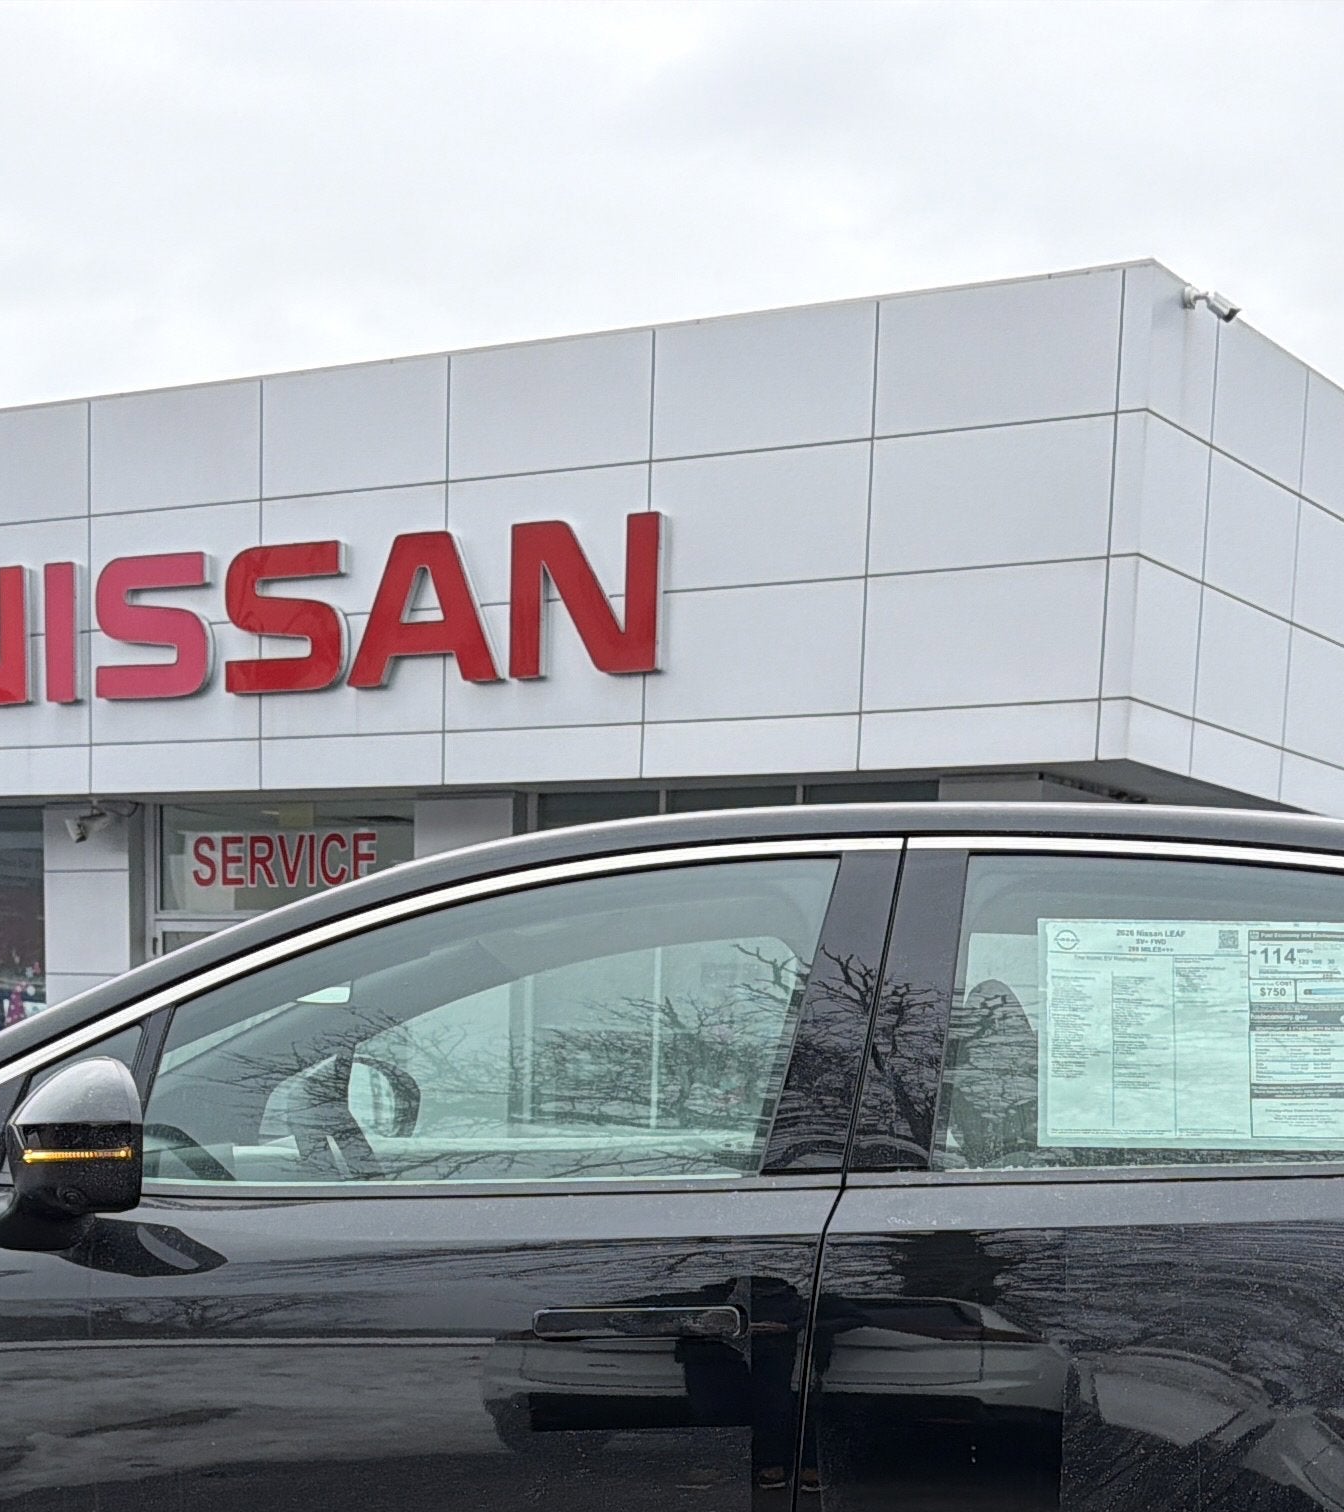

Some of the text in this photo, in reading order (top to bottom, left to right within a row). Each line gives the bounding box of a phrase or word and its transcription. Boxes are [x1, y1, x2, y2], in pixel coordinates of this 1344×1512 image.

[192, 832, 377, 887] SERVICE
[1165, 930, 1186, 938] LEAF
[1260, 947, 1296, 965] 114
[1260, 987, 1286, 996] $750
